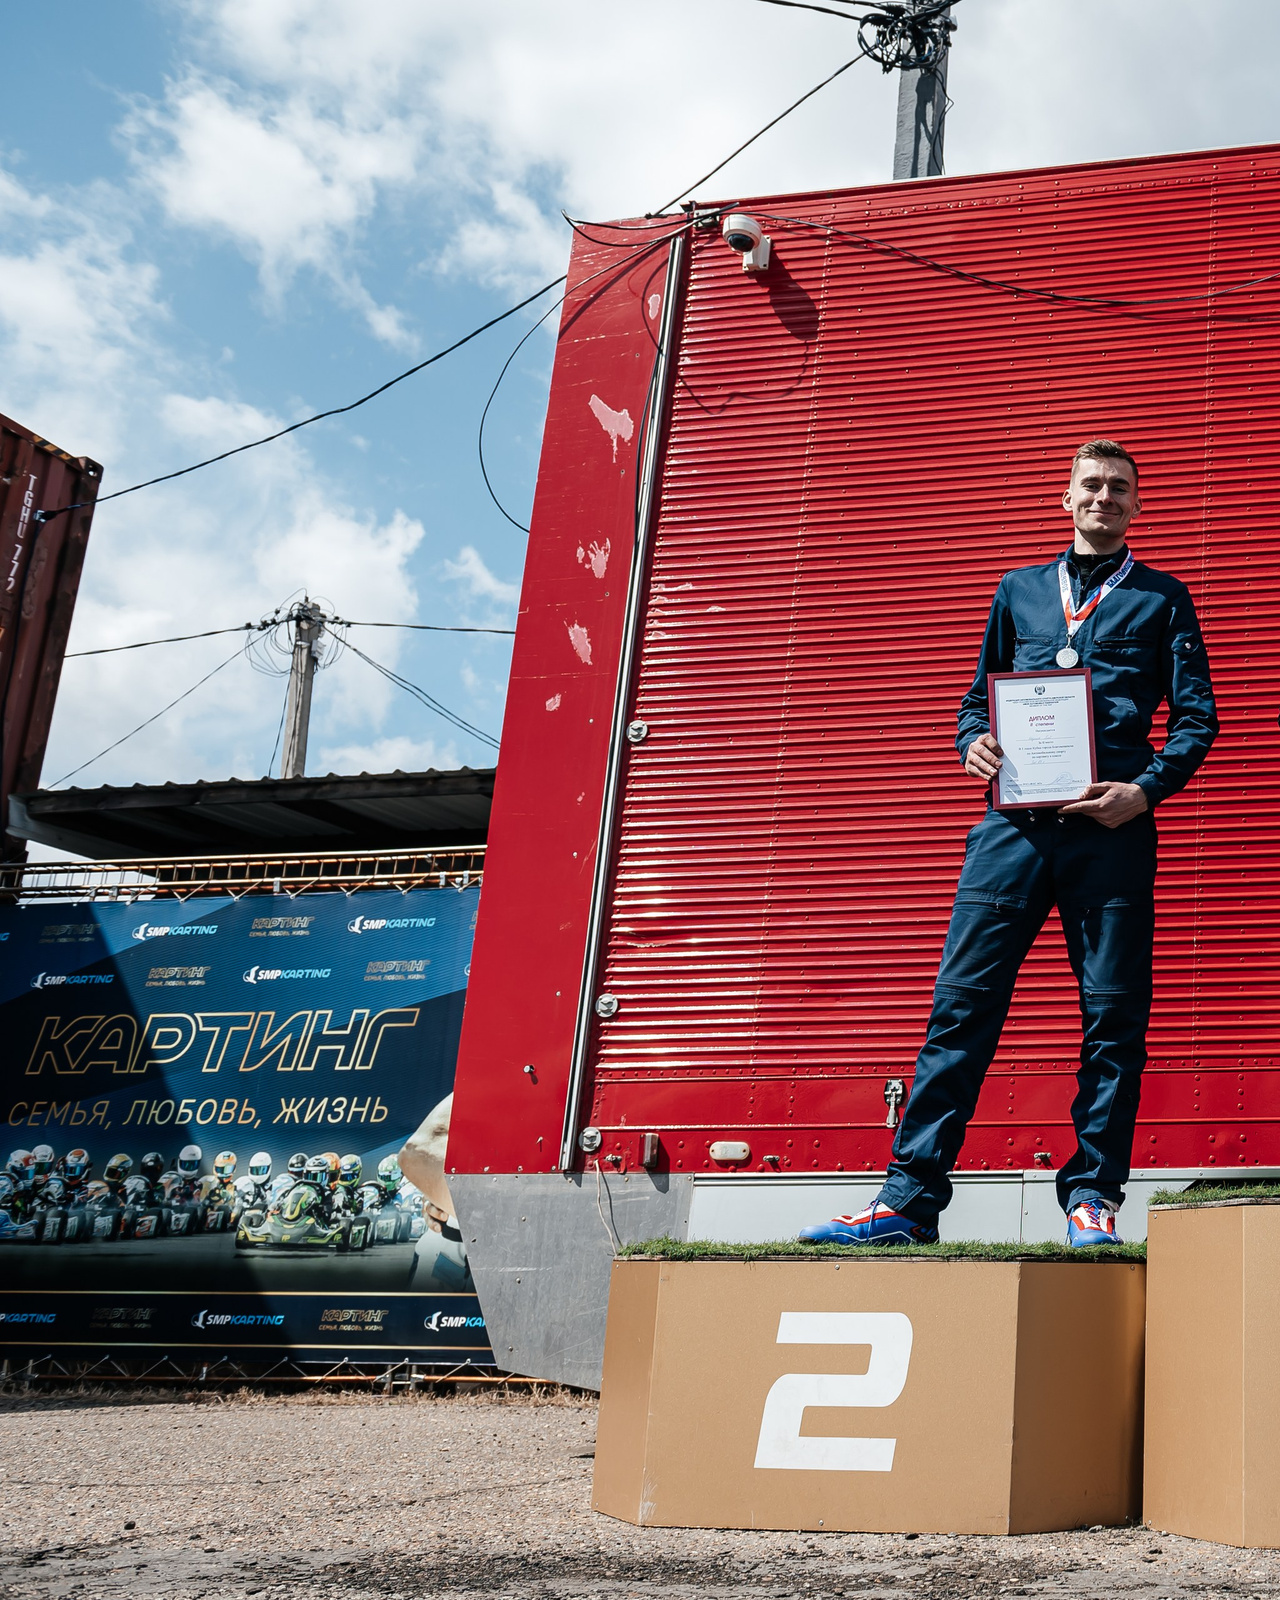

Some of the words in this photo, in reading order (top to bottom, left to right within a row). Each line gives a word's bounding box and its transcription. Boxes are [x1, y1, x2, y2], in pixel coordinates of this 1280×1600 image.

[16, 474, 37, 538] TGHU
[1028, 714, 1055, 722] ДИПЛОМ
[251, 916, 316, 930] КАРТИНГ
[361, 917, 436, 930] SMPKARTING
[146, 925, 218, 937] SMPKARTING
[148, 966, 211, 979] КАРТИНГ
[366, 959, 431, 973] КАРТИНГ
[44, 974, 114, 986] SMPKARTING
[257, 968, 331, 981] SMPKARTING
[25, 1008, 420, 1075] КАРТИНГ
[8, 1101, 113, 1130] СЕМЬЯ,
[122, 1098, 262, 1129] ЛЮБОВЬ,
[273, 1096, 389, 1124] ЖИЗНЬ
[0, 1313, 56, 1323] PKARTING
[206, 1314, 285, 1326] SMPKARTING
[321, 1309, 389, 1322] КАРТИНГ
[754, 1312, 913, 1471] 2
